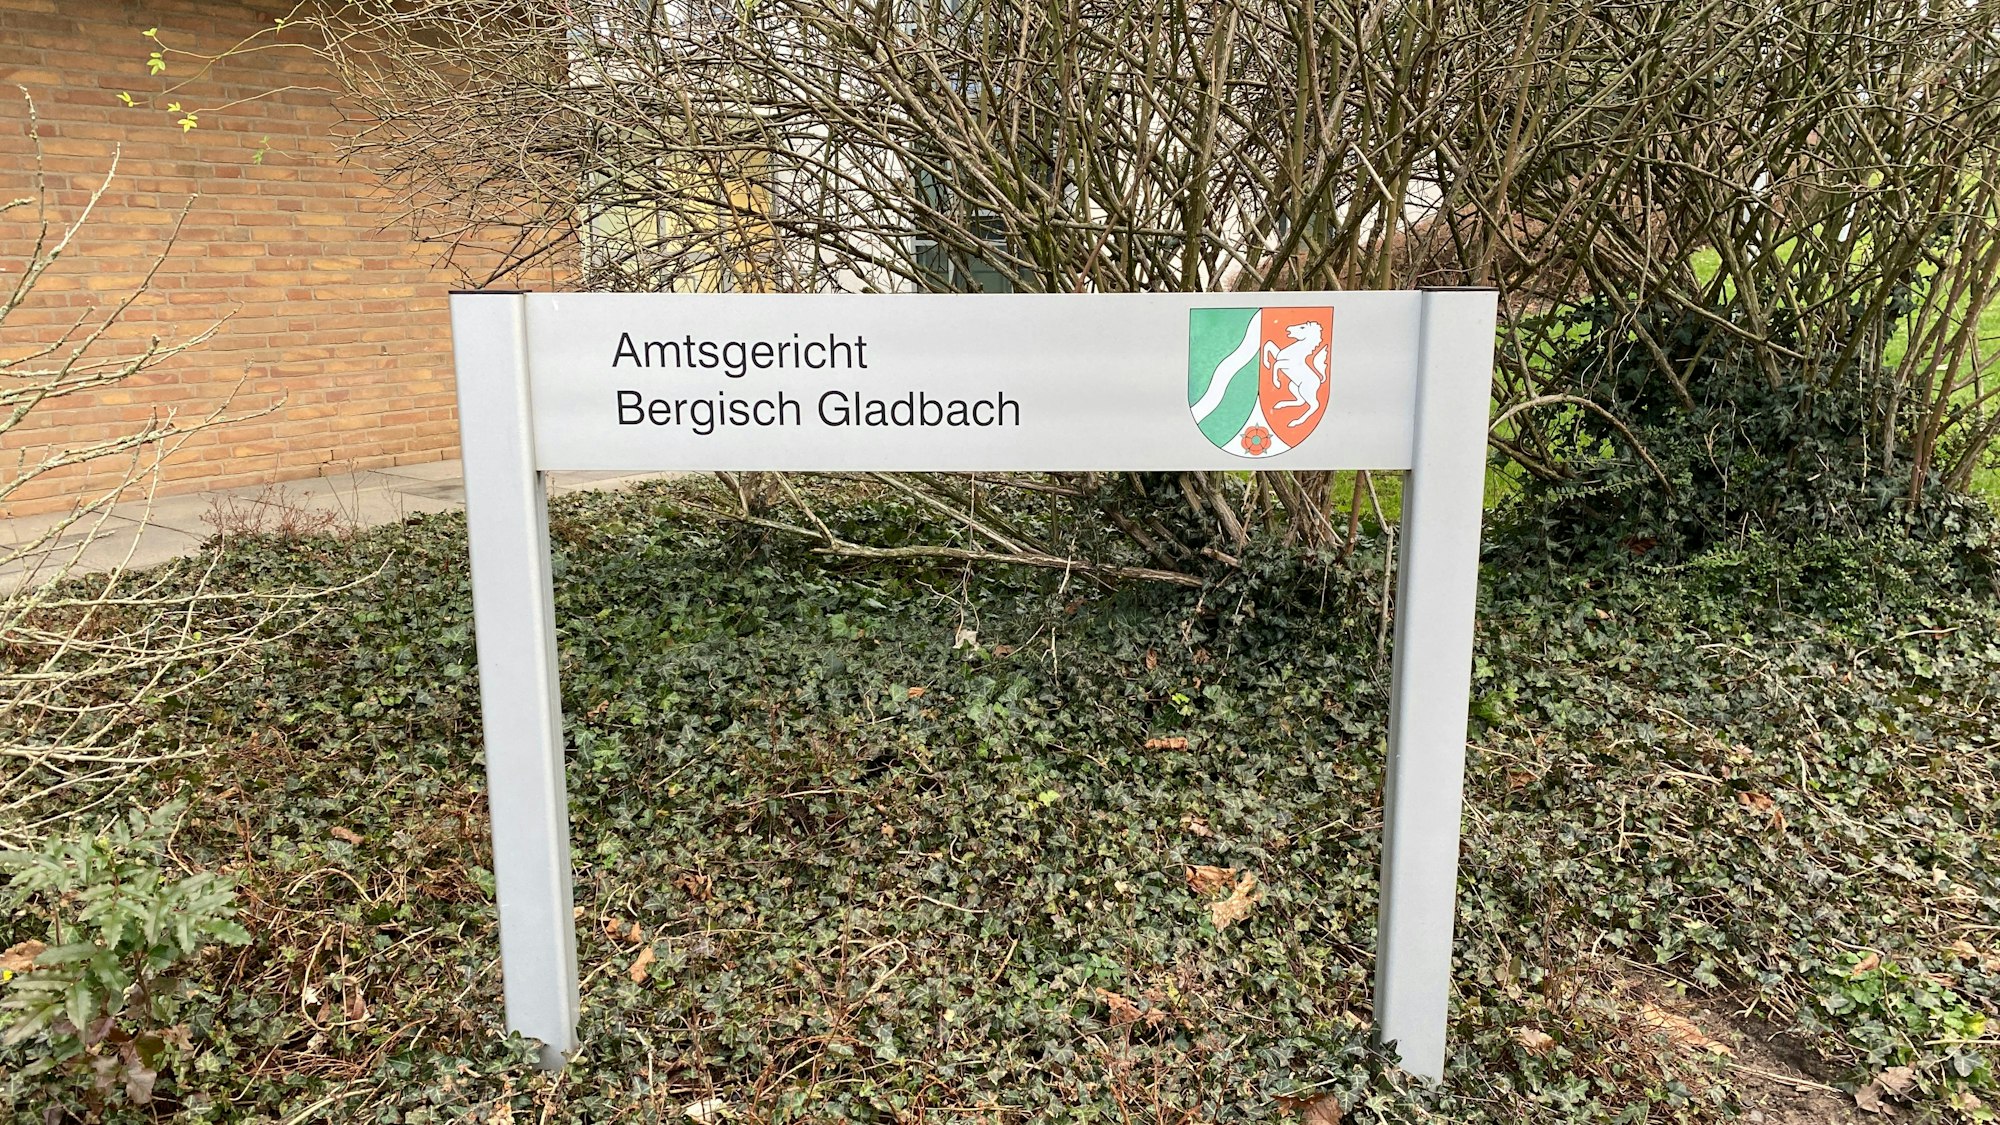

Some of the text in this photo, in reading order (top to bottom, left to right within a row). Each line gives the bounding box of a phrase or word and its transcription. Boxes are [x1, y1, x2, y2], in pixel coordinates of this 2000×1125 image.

[613, 333, 867, 379] Amtsgericht
[617, 390, 1020, 436] Bergisch Gladbach
